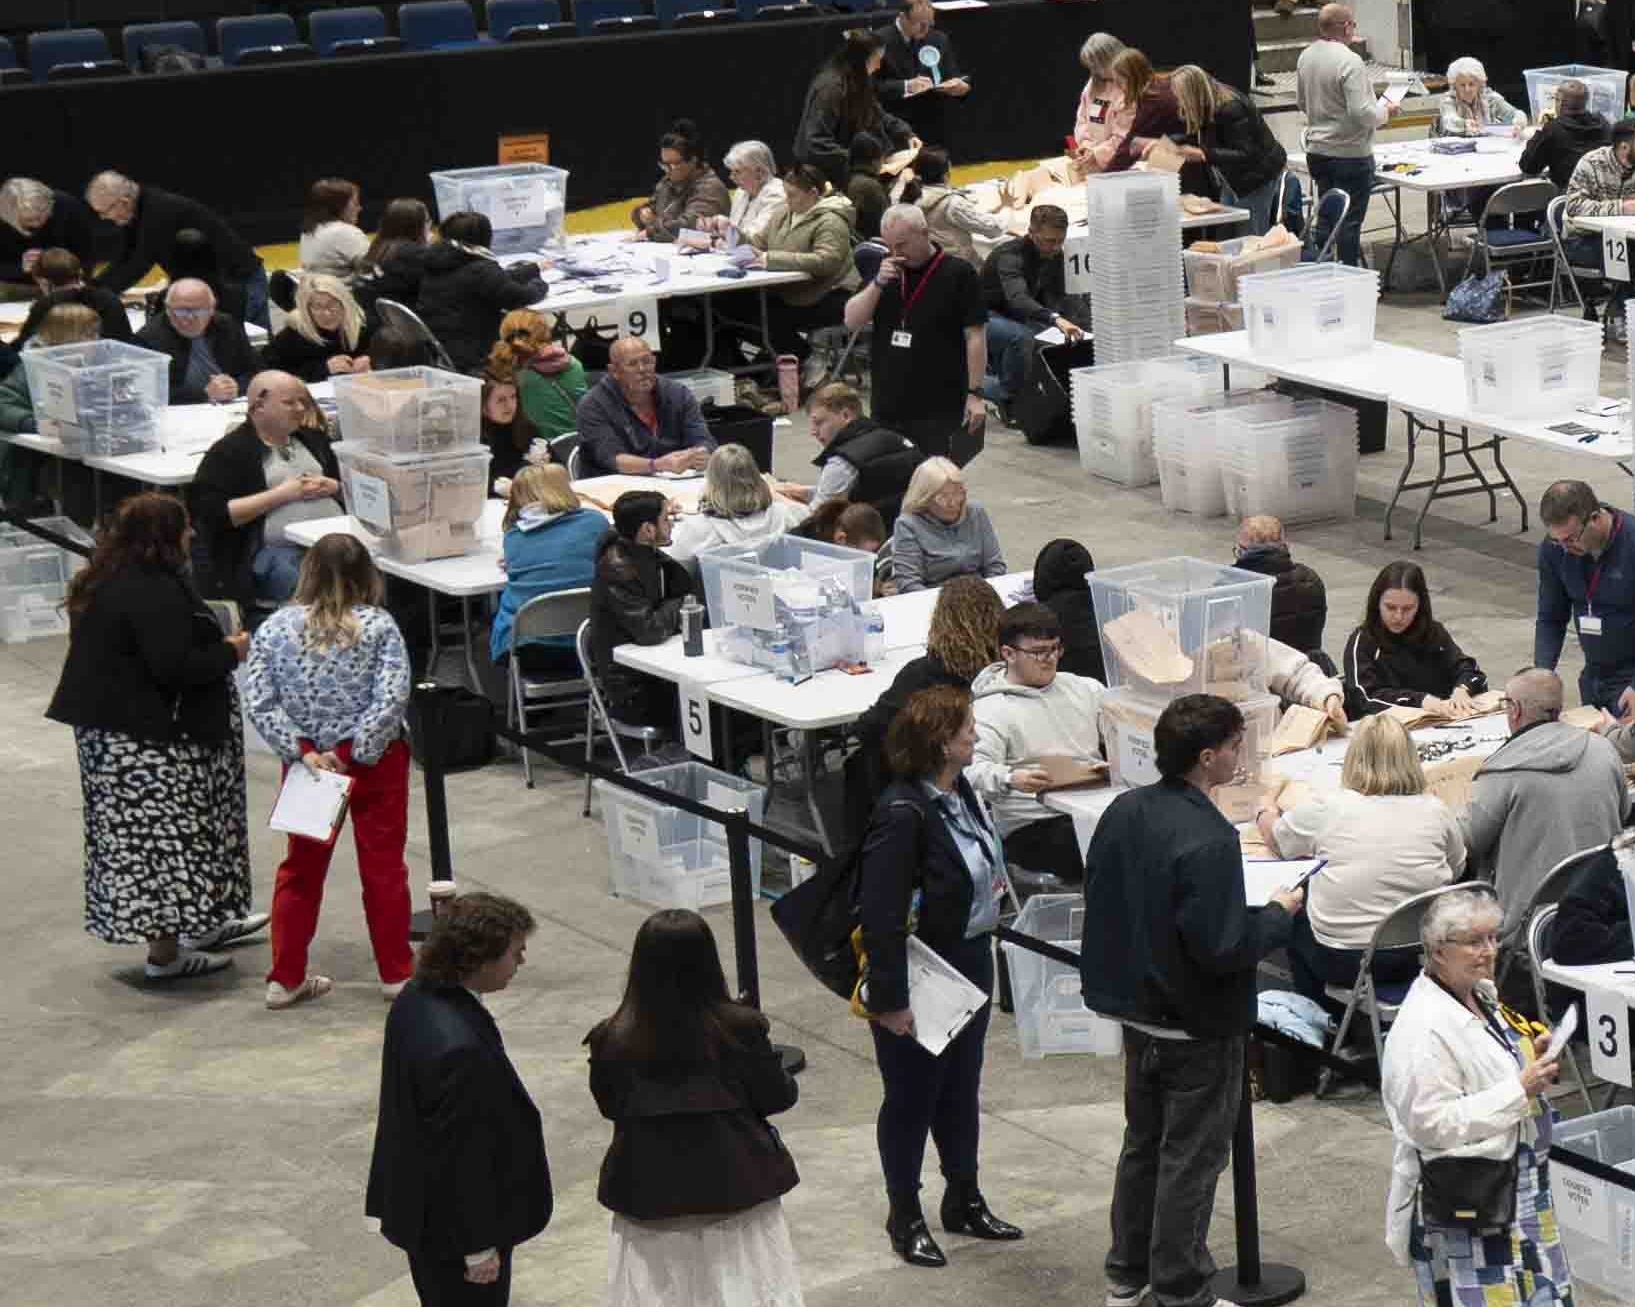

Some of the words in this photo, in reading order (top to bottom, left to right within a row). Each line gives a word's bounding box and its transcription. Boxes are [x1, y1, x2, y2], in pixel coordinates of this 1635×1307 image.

[1605, 239, 1626, 263] 12
[628, 311, 647, 337] 9
[688, 699, 702, 735] 5
[1598, 1014, 1617, 1058] 3
